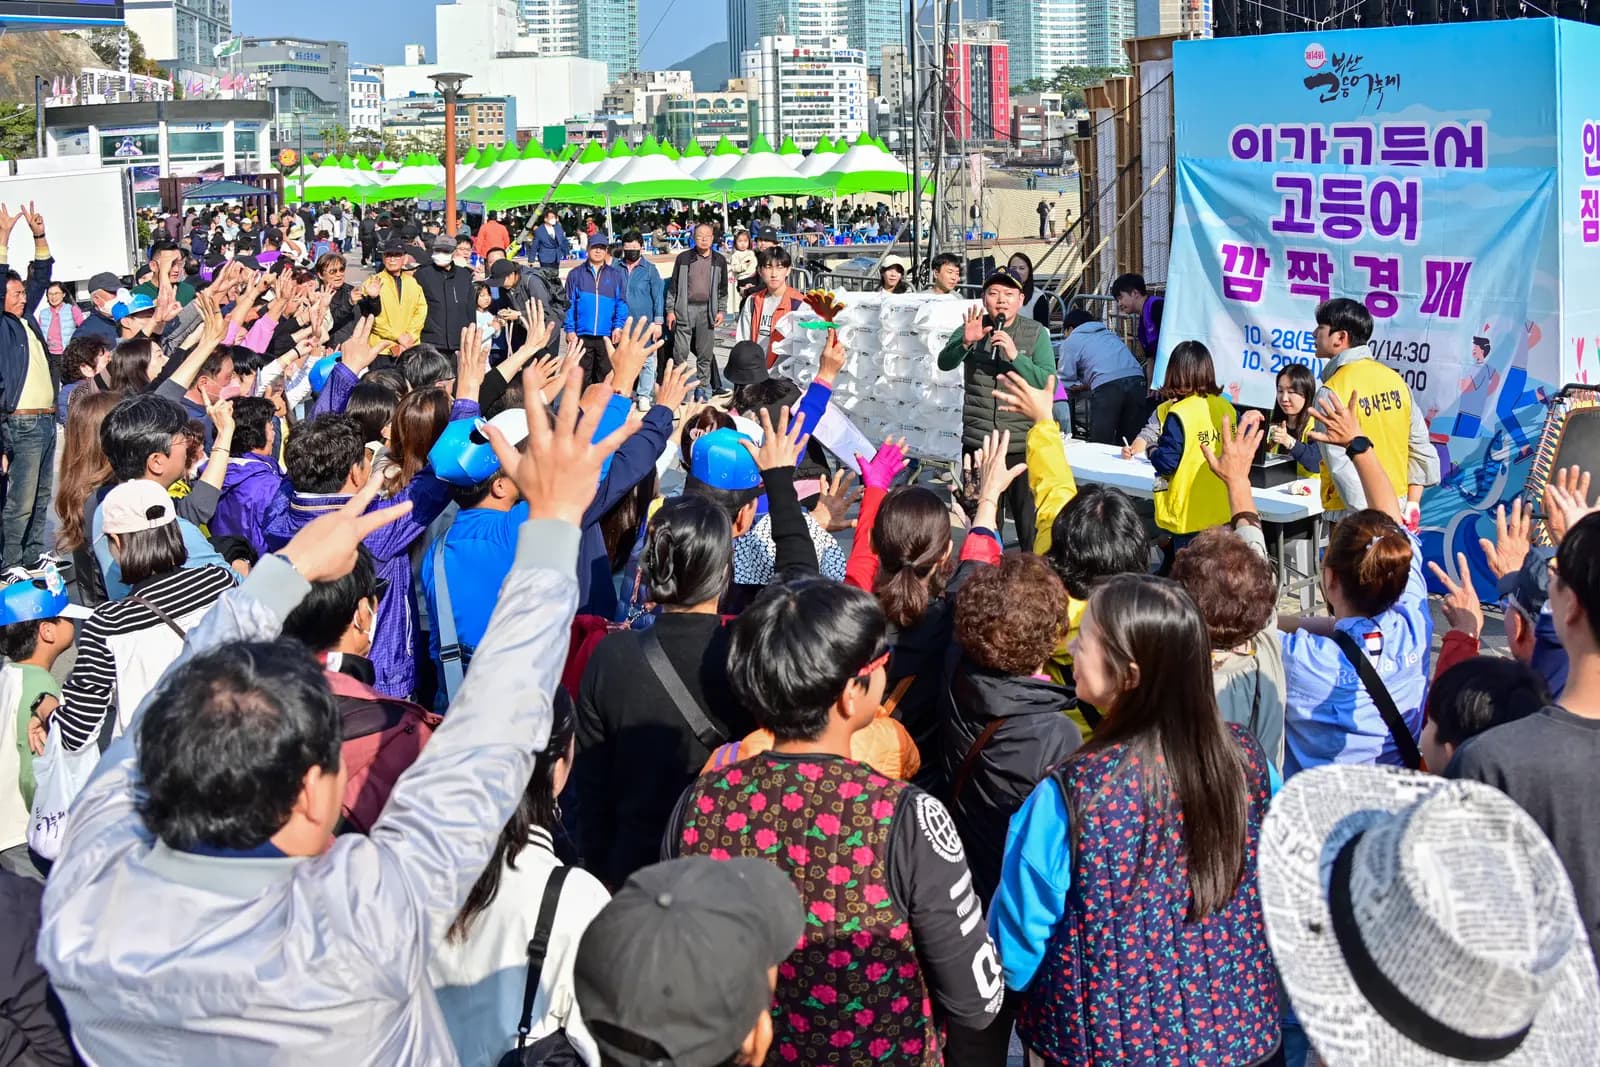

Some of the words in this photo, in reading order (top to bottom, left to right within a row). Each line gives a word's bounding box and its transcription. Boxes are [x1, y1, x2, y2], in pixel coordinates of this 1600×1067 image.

[1331, 52, 1364, 76] 부산
[1272, 176, 1418, 241] 고등어
[1244, 324, 1266, 347] 10.
[1242, 349, 1265, 373] 10.
[1358, 388, 1402, 417] 행사진행
